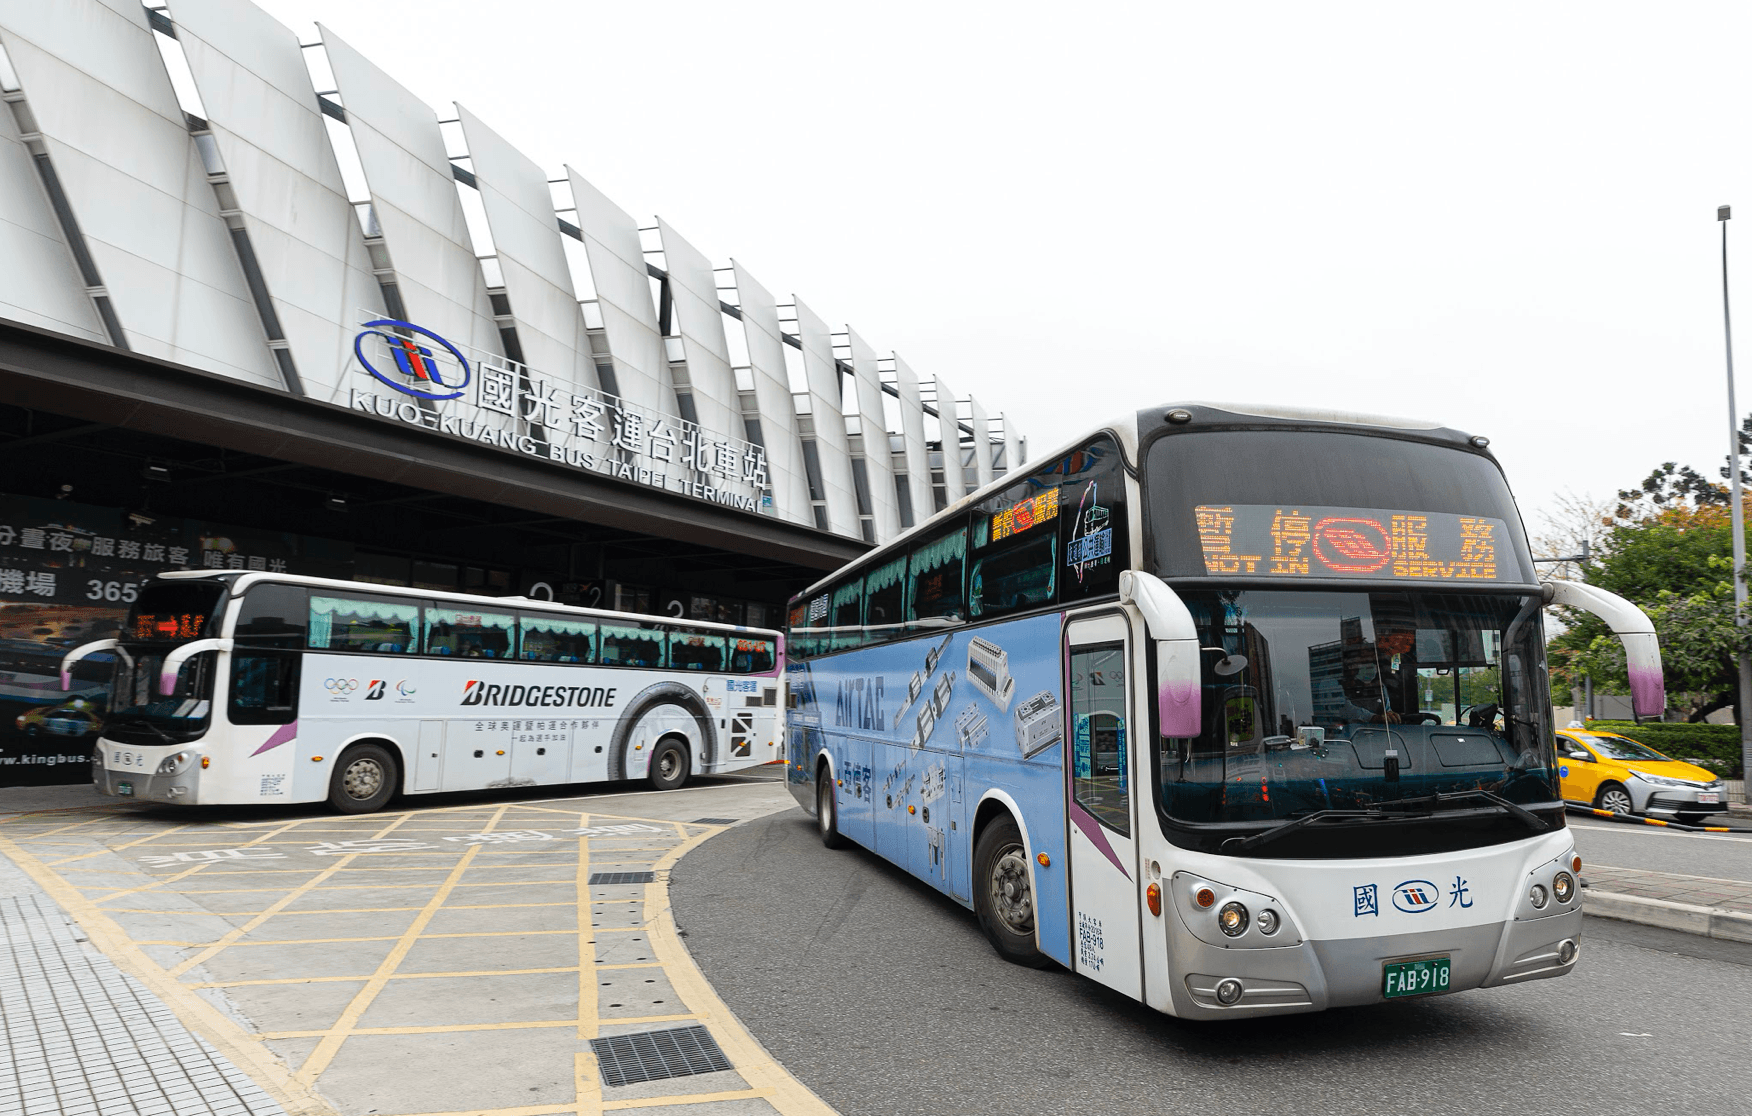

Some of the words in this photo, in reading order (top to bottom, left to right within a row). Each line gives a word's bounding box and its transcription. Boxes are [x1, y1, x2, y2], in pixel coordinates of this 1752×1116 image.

[478, 361, 767, 490] 國光客運台北車站
[351, 388, 537, 455] KUO-KUANG
[548, 442, 595, 470] BUS
[606, 459, 667, 489] TAIPEI
[679, 478, 766, 514] TERMINAL
[1203, 554, 1261, 574] NOT
[1271, 556, 1309, 575] IN
[1393, 560, 1498, 579] SERVICE
[460, 680, 617, 708] BRIDGESTONE
[1353, 883, 1379, 918] 國
[1448, 875, 1474, 910] 光
[1079, 928, 1104, 950] FAB-918
